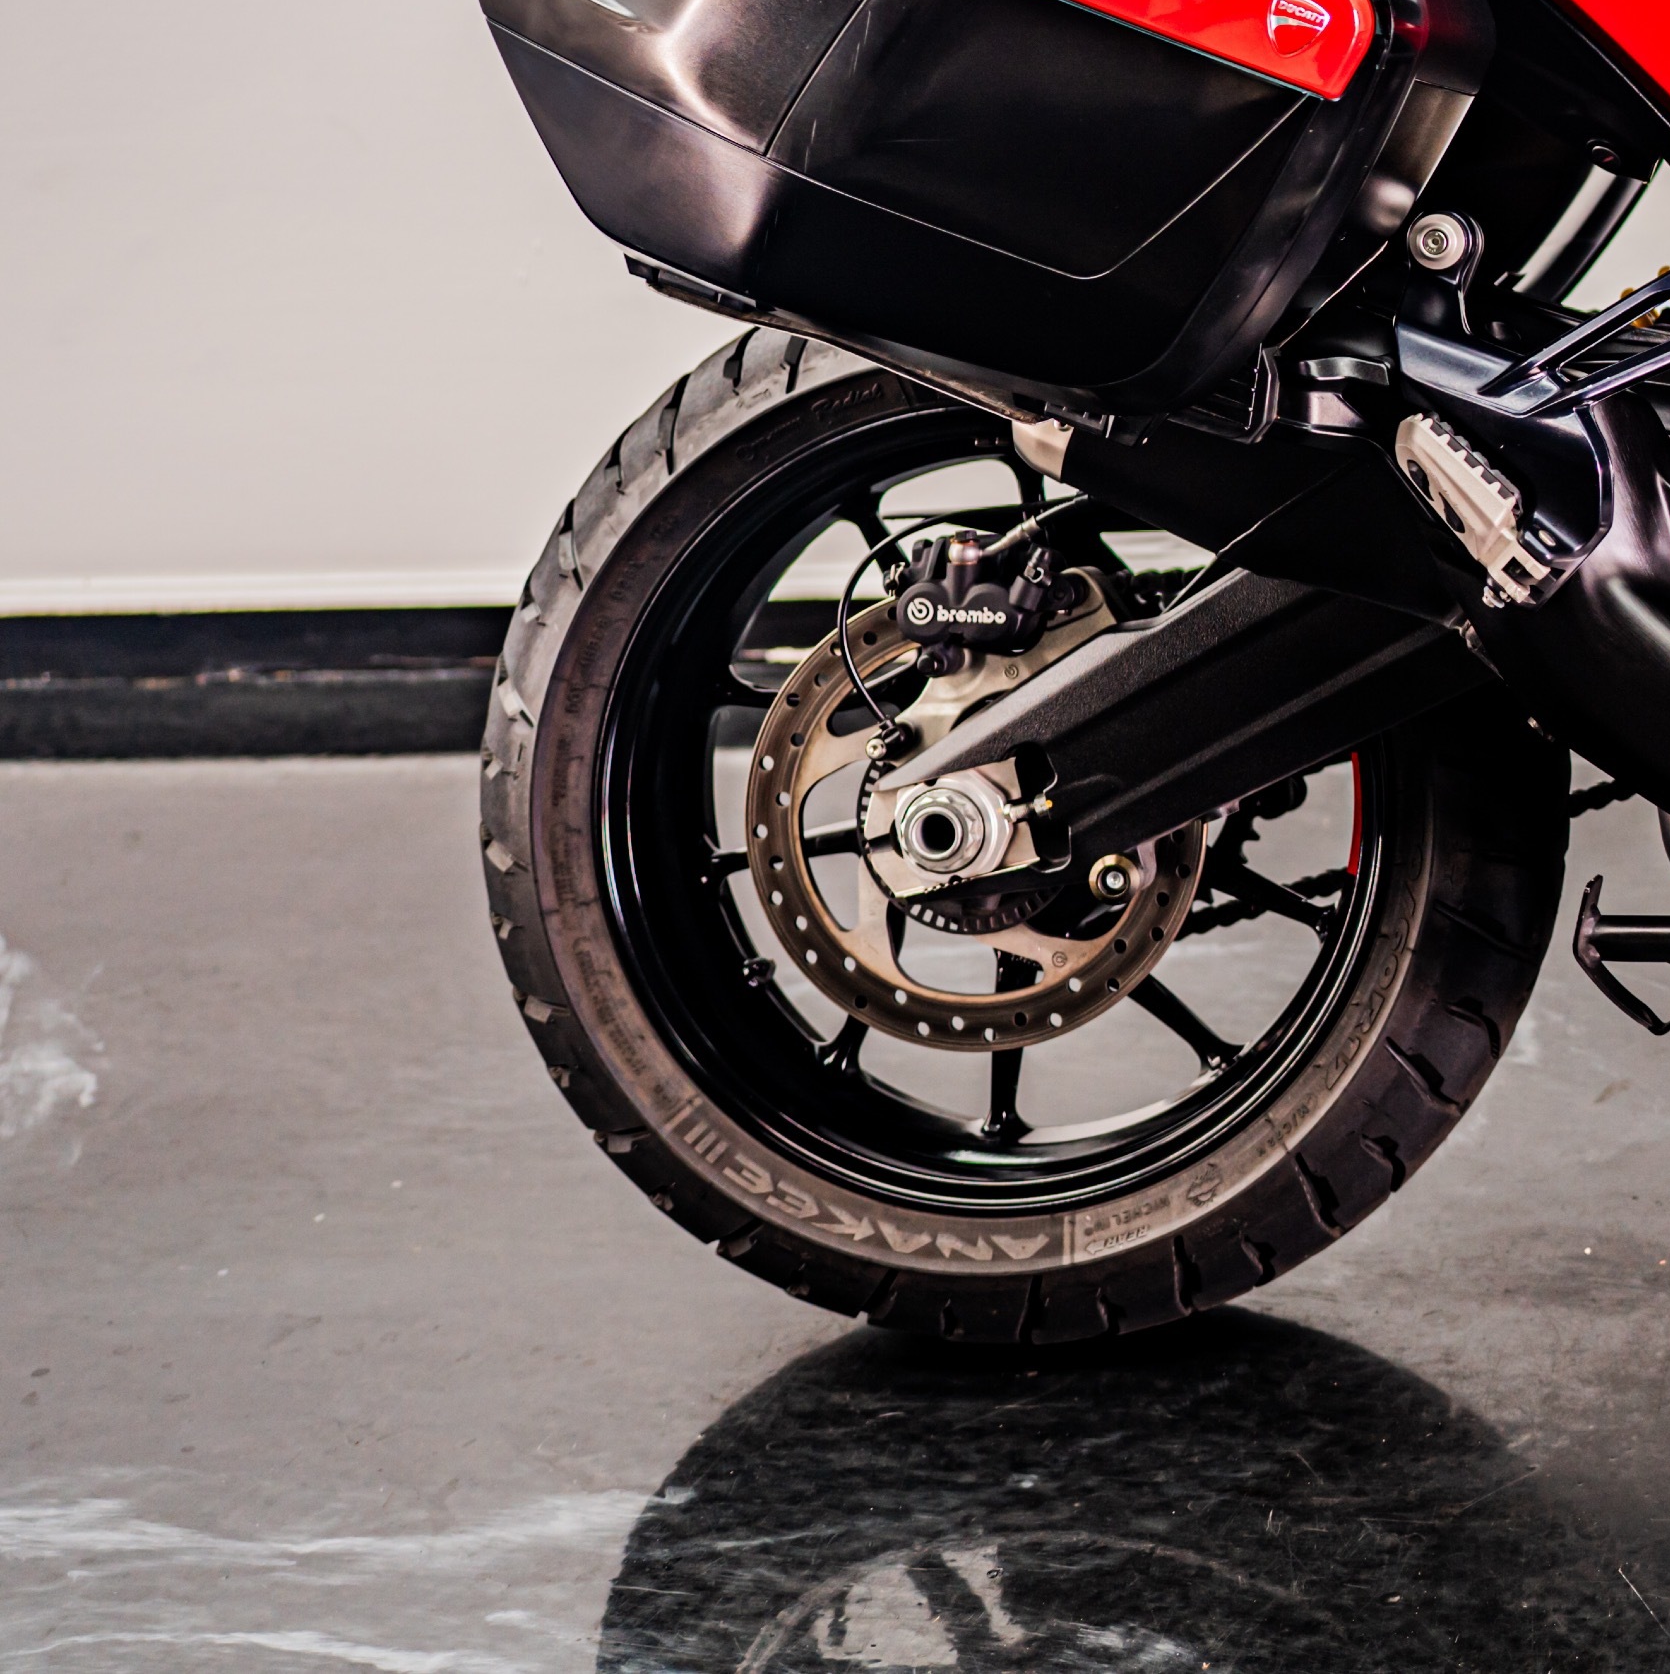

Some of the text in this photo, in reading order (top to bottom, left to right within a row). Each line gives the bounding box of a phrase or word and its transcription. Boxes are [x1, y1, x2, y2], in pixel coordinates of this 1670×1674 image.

[1278, 0, 1325, 24] DUCATI
[812, 383, 883, 420] Radial
[938, 605, 1006, 624] brembo
[686, 1120, 1049, 1260] ANAKEE III
[1102, 1226, 1150, 1248] REAR
